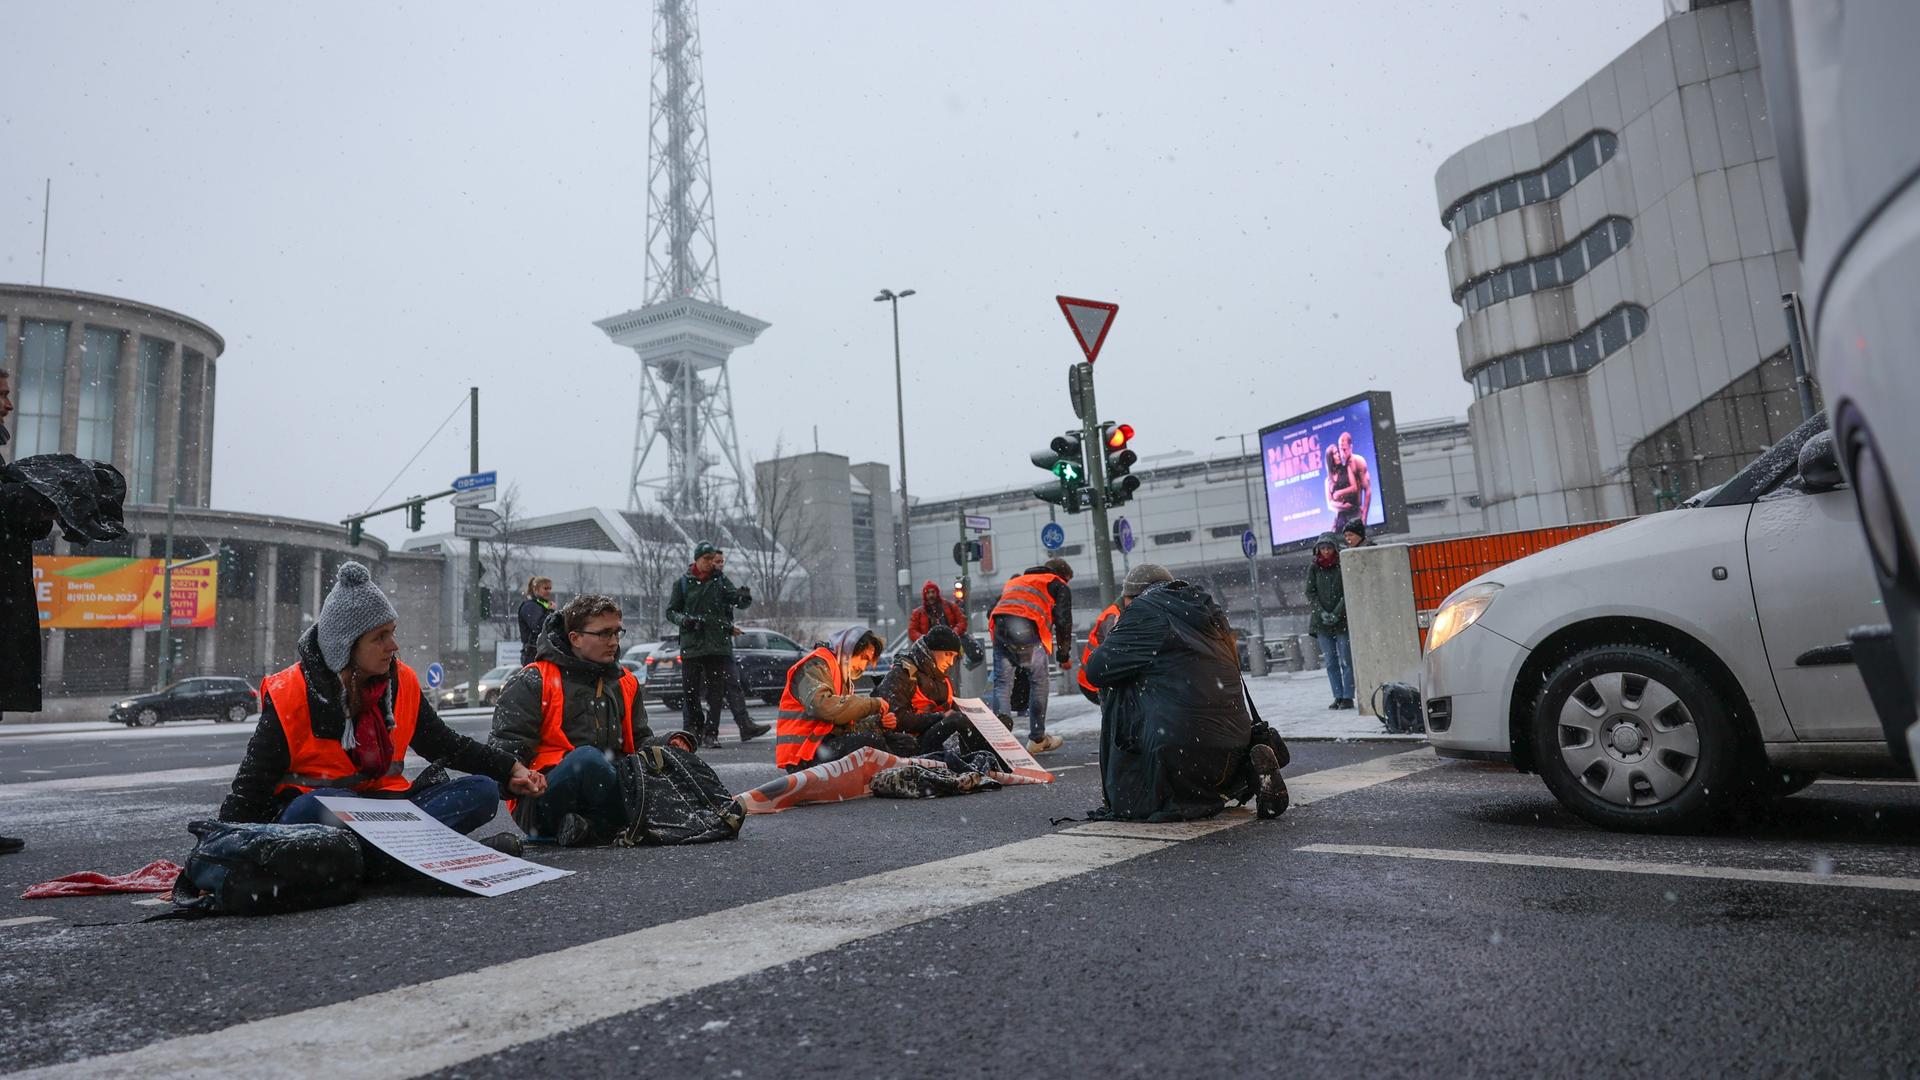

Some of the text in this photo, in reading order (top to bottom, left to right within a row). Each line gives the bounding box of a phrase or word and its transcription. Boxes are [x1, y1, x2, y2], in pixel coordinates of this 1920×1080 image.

[1268, 434, 1320, 465] MAGIC
[1271, 451, 1322, 481] MIKE
[1286, 475, 1300, 485] LAST
[67, 582, 95, 591] Berlin
[98, 593, 113, 602] Feb
[115, 593, 137, 602] 2023
[171, 600, 193, 608] OUTH
[349, 811, 422, 822] ERINNERUNG
